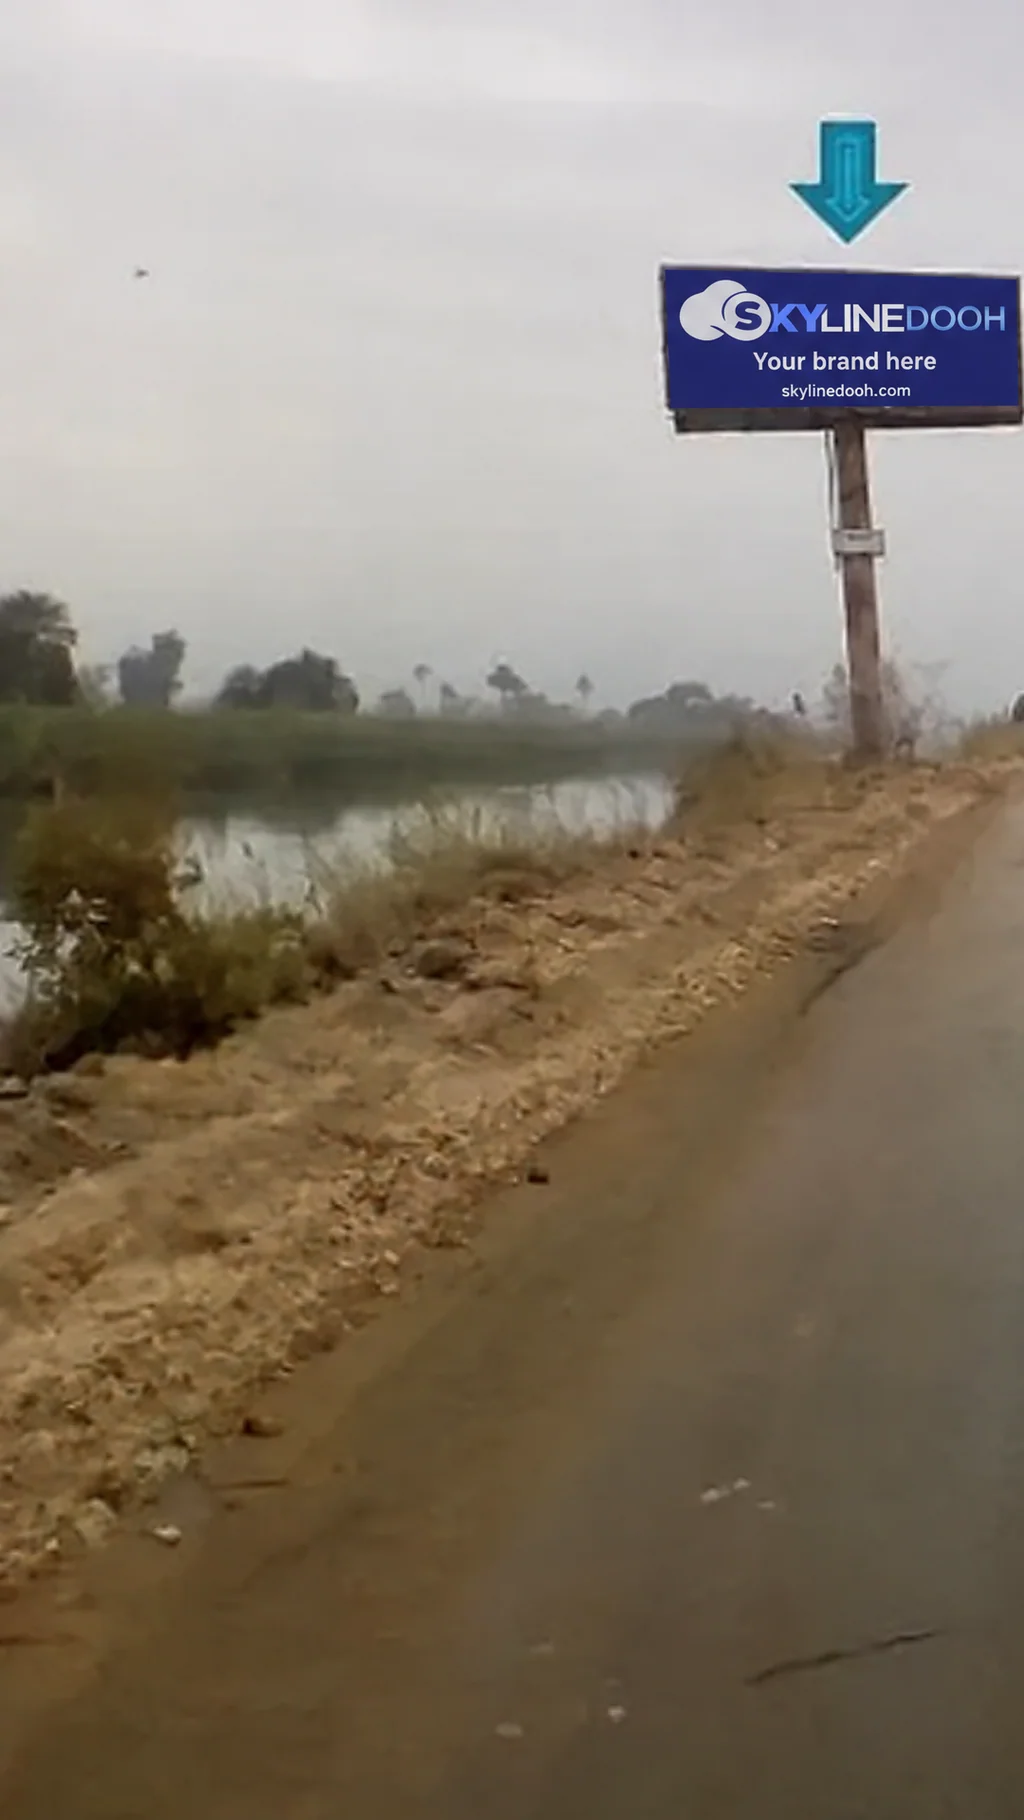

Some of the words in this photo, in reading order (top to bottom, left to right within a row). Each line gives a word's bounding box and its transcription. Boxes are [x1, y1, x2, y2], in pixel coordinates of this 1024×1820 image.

[753, 352, 806, 371] Your
[812, 351, 879, 371] brand
[886, 351, 937, 371] here
[781, 383, 911, 400] skylinedooh.com
